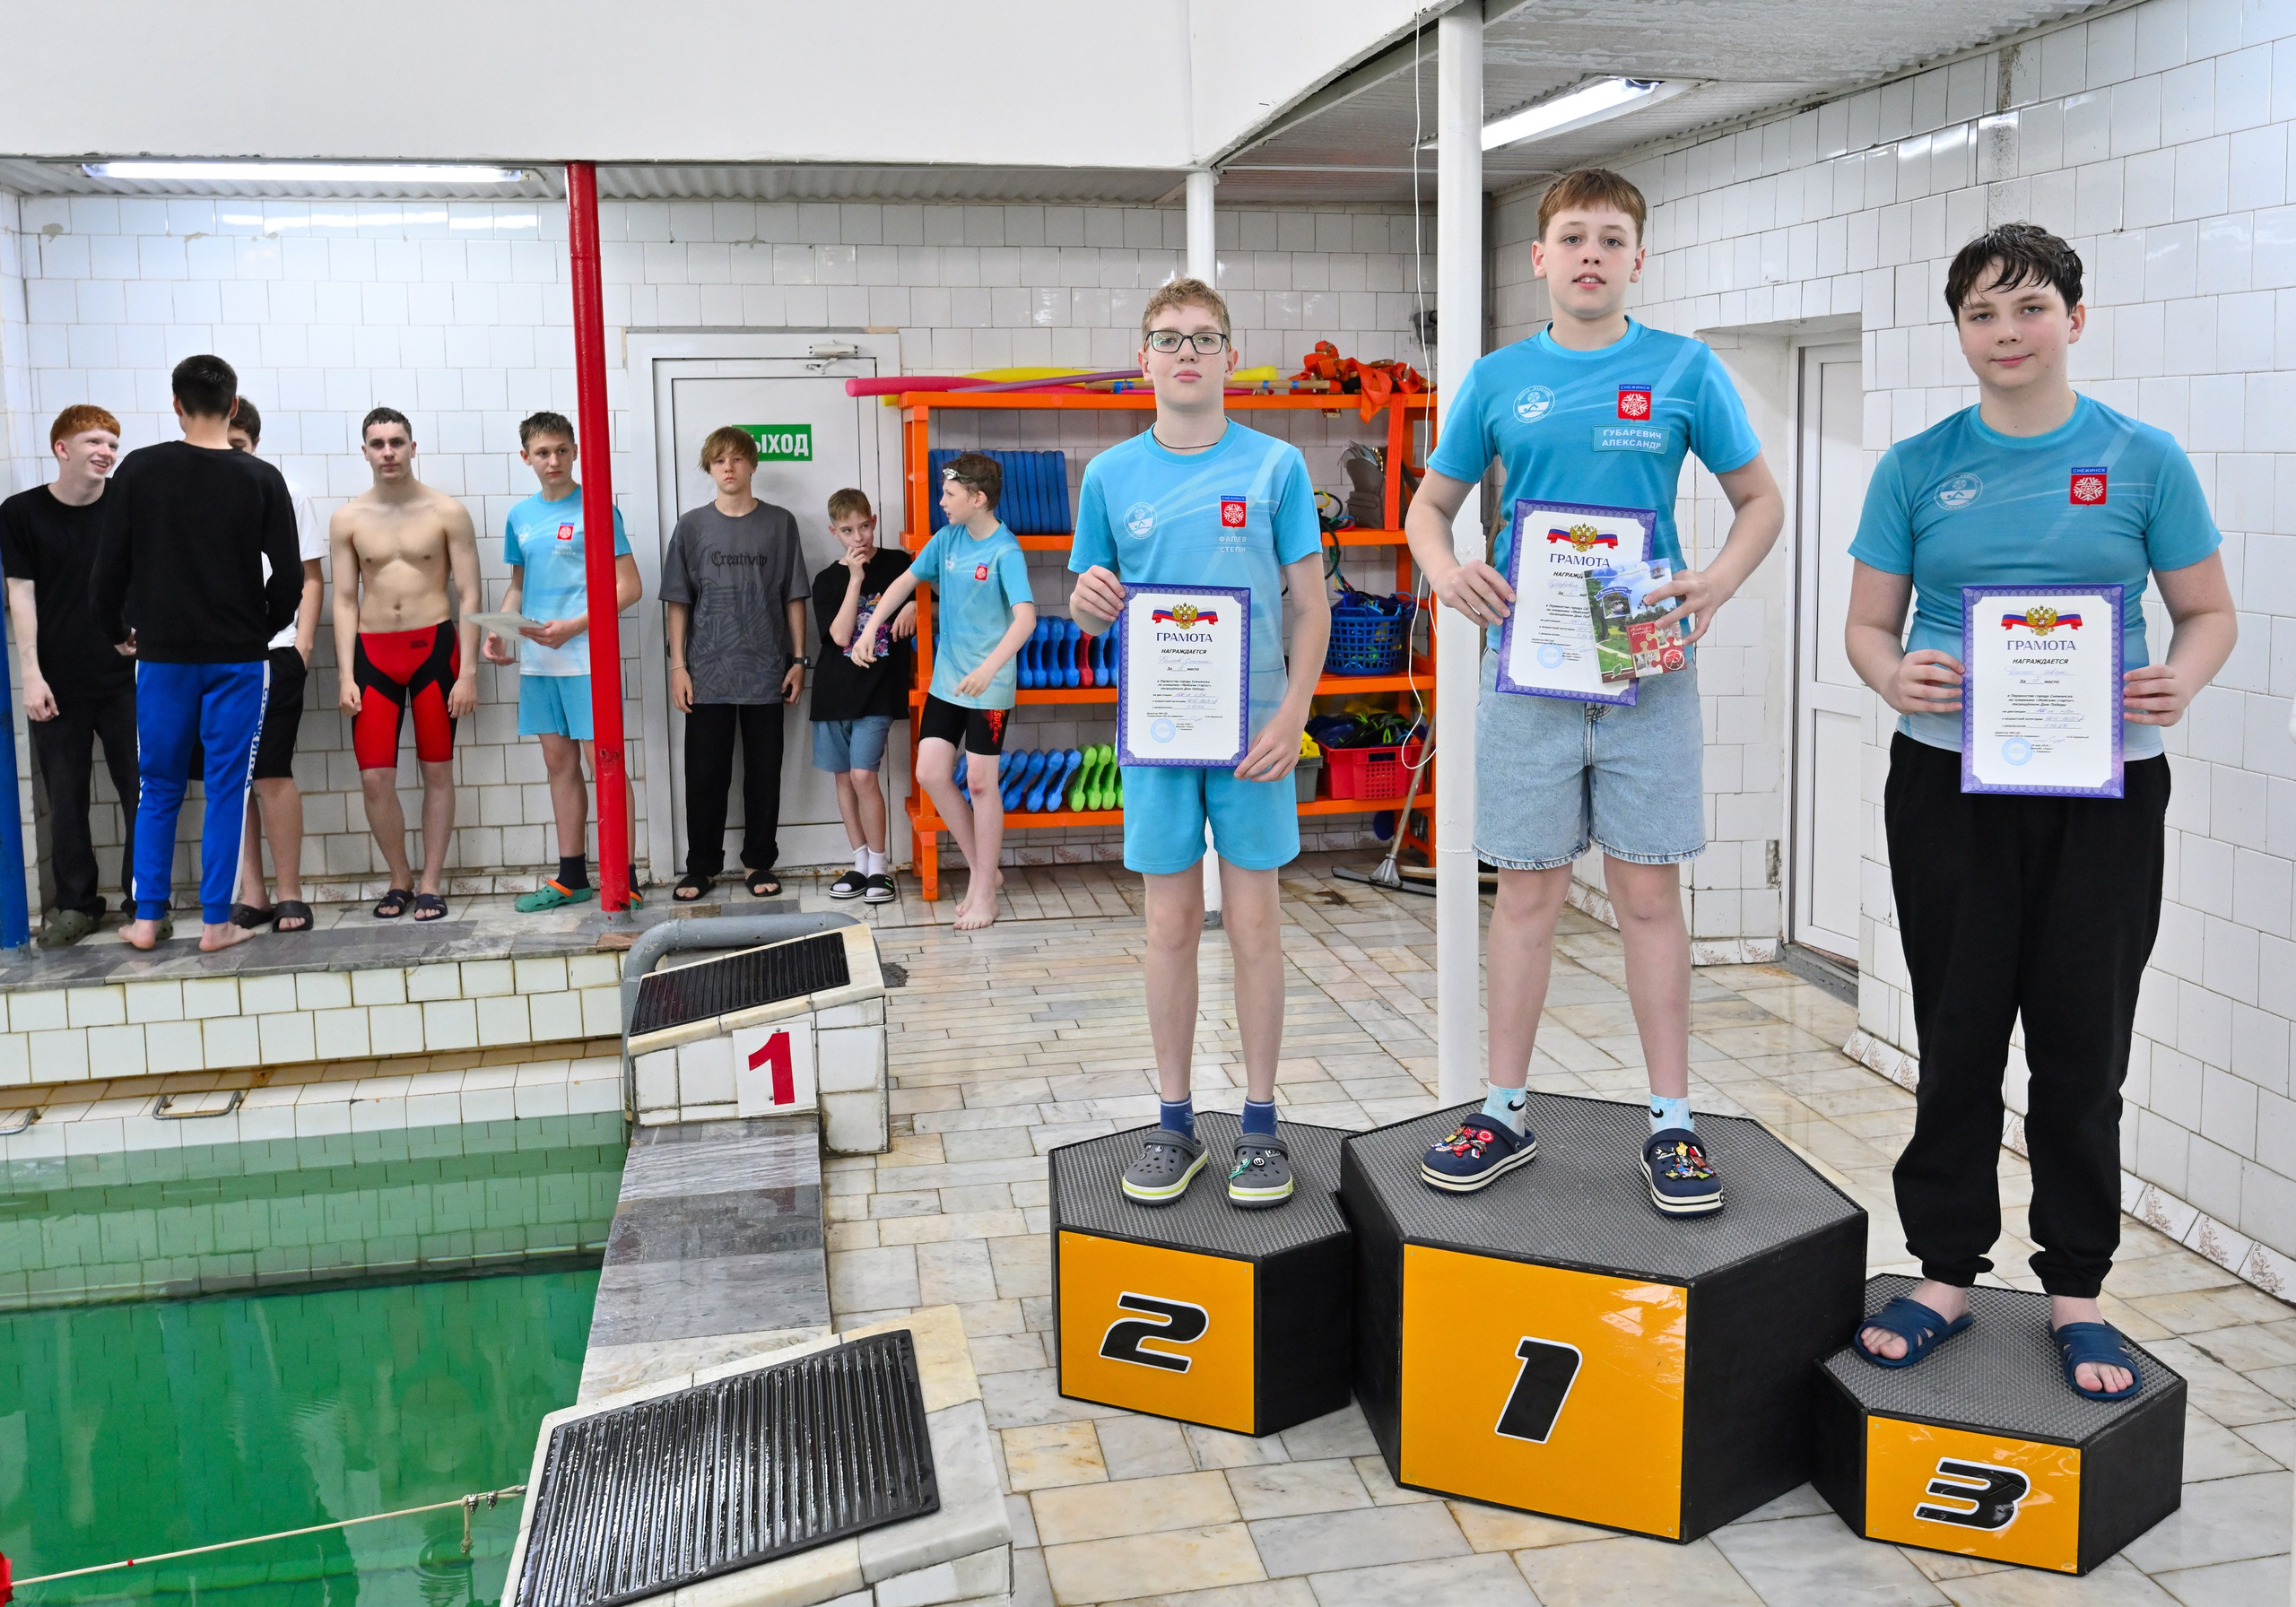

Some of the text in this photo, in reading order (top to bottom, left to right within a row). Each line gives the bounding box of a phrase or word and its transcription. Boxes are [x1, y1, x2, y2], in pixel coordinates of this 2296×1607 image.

[1602, 439, 1661, 449] АЛЕКСАНДР
[1603, 430, 1662, 439] ГУБАРЕВИЧ
[753, 433, 809, 457] ЫХОД
[710, 550, 768, 570] Creativity
[1550, 552, 1611, 568] ГРАМОТА
[1156, 632, 1213, 643] ГРАМОТА
[2006, 639, 2076, 651] ГРАМОТА
[747, 1031, 796, 1106] 1
[1099, 1291, 1210, 1374] 2
[1494, 1335, 1583, 1445] 1
[1913, 1456, 2031, 1532] 3
